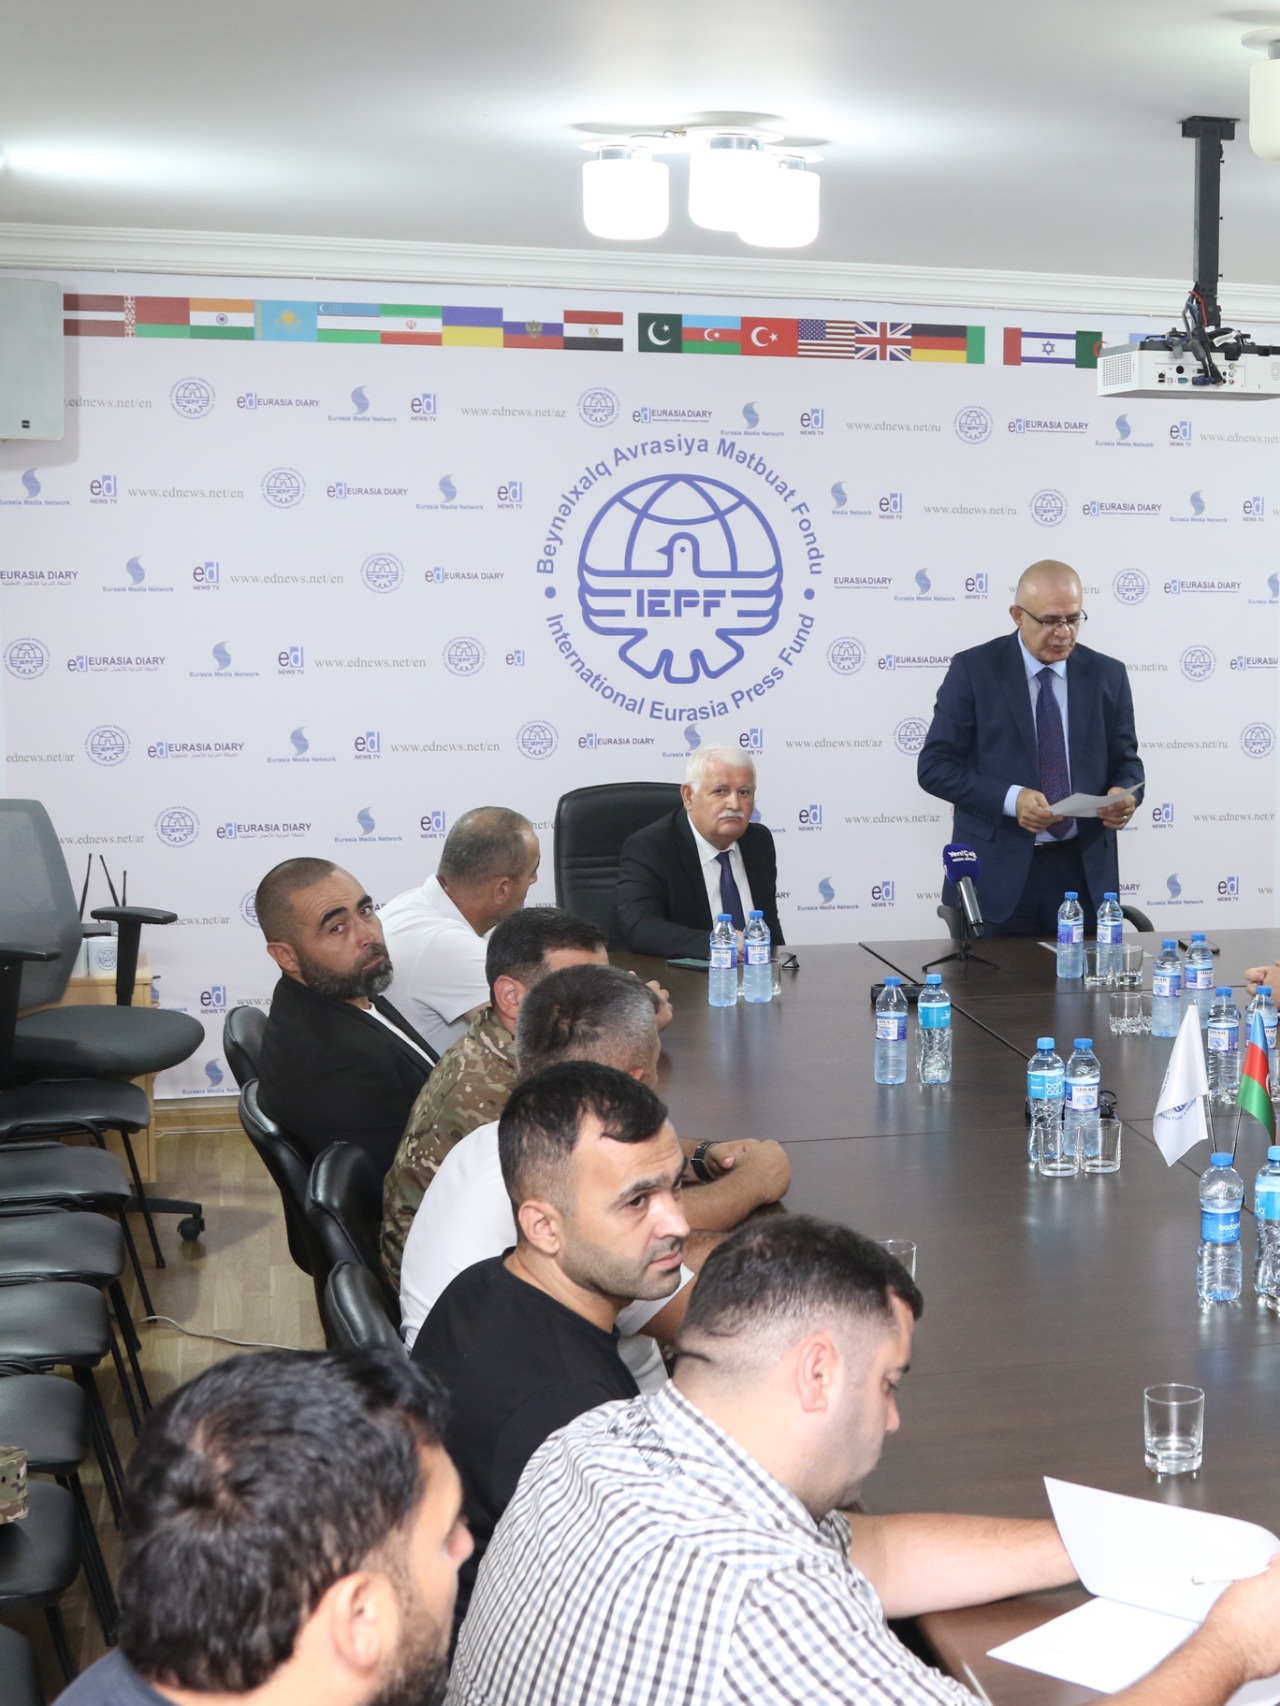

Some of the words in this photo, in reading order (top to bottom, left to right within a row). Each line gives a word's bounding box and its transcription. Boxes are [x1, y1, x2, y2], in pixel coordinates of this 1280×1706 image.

[236, 393, 257, 409] ed
[411, 393, 436, 414] ed
[461, 407, 567, 417] www.ednews.net/az
[632, 407, 651, 423] ed
[800, 408, 824, 429] ed
[846, 420, 941, 431] www.ednews.net/ru
[1008, 418, 1025, 434] ed
[1026, 420, 1062, 428] EURASIA
[1169, 420, 1192, 440] ed
[90, 475, 117, 497] ed
[128, 487, 244, 498] www.ednews.net/en
[327, 482, 347, 499] ed
[498, 481, 522, 501] ed
[537, 461, 612, 574] Beynəlxalq
[613, 433, 708, 466] Avrasiya
[717, 438, 797, 502] Mətbuat
[791, 502, 824, 574] Fondu
[879, 493, 902, 513] ed
[924, 505, 1017, 515] www.ednews.net/ru
[1082, 501, 1099, 516] ed
[1099, 503, 1135, 511] EURASIA
[1243, 496, 1264, 516] ed
[0, 571, 45, 579] EURASIA
[48, 571, 78, 579] DIARY
[193, 562, 219, 584] ed
[230, 574, 344, 584] www.ednews.net/en
[425, 567, 444, 584] ed
[965, 573, 988, 594] ed
[1164, 580, 1180, 594] ed
[1181, 581, 1215, 589] EURASIA
[636, 589, 726, 617] IEPF
[67, 655, 88, 672] ed
[89, 657, 133, 665] EURASIA
[136, 657, 165, 665] DIARY
[278, 646, 303, 668] ed
[314, 658, 426, 668] www.ednews.net/en
[506, 650, 525, 666] ed
[878, 654, 896, 671] ed
[1230, 656, 1246, 671] ed
[547, 614, 645, 715] International
[649, 700, 729, 721] Eurasia
[731, 667, 784, 709] Press
[779, 613, 815, 666] Fund
[355, 731, 380, 753] ed
[390, 741, 500, 751] www.ednews.net/en
[578, 733, 597, 749] ed
[739, 728, 762, 748] ed
[785, 738, 883, 748] www.ednews.net/az
[1141, 740, 1228, 749] www.ednews.net/ru
[6, 753, 75, 762] ednews.net/ar
[147, 742, 168, 759] ed
[168, 743, 212, 752] EURASIA
[214, 743, 243, 751] DIARY
[799, 804, 822, 824] ed
[844, 814, 940, 823] www.ednews.net/az
[1152, 803, 1174, 822] ed
[420, 811, 445, 832] ed
[216, 823, 236, 839] ed
[237, 824, 280, 832] EURASIA
[283, 823, 311, 831] DIARY
[872, 881, 894, 900] ed
[1218, 876, 1239, 896] ed
[200, 986, 226, 1007] ed
